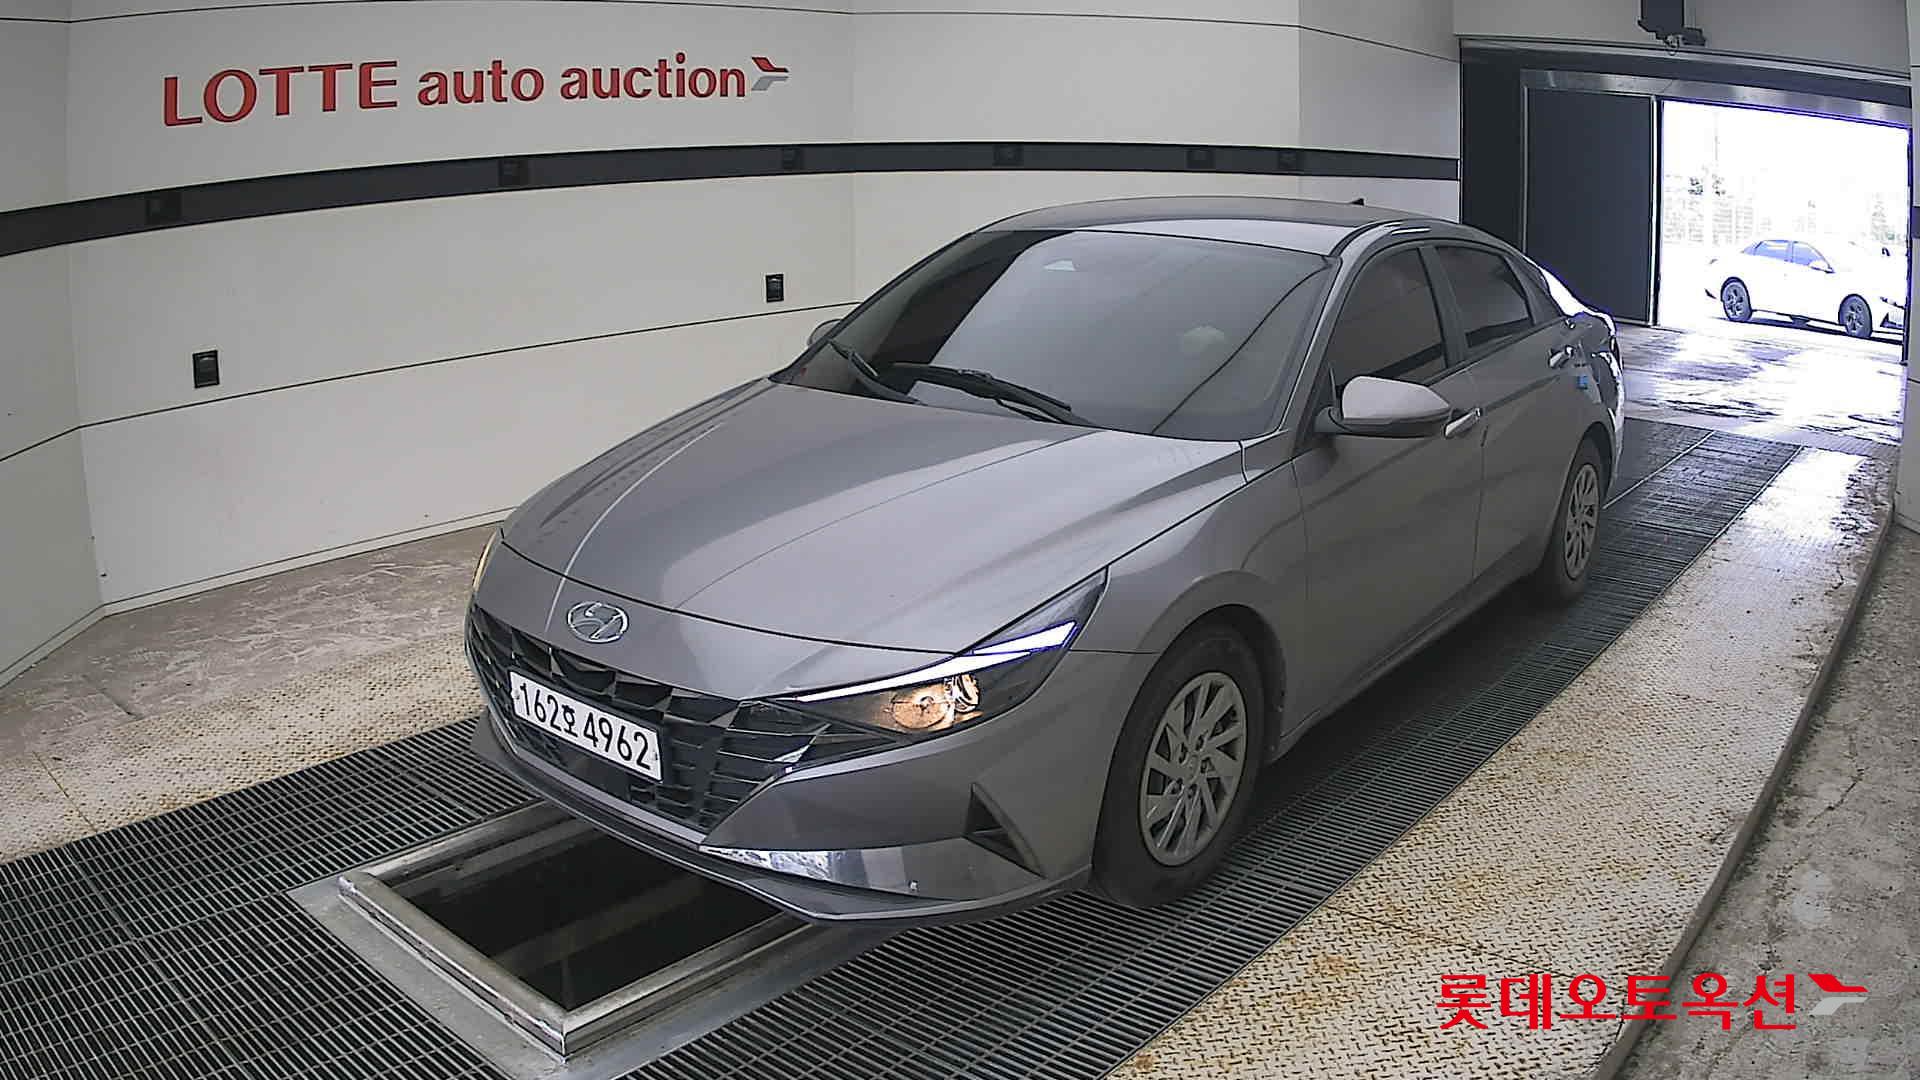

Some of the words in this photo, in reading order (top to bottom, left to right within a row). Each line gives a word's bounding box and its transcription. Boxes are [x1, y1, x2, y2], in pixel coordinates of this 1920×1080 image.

[163, 59, 398, 127] LOTTE
[416, 59, 546, 106] auto
[559, 52, 747, 99] auction
[519, 682, 579, 738] 162호
[583, 711, 651, 771] 4962
